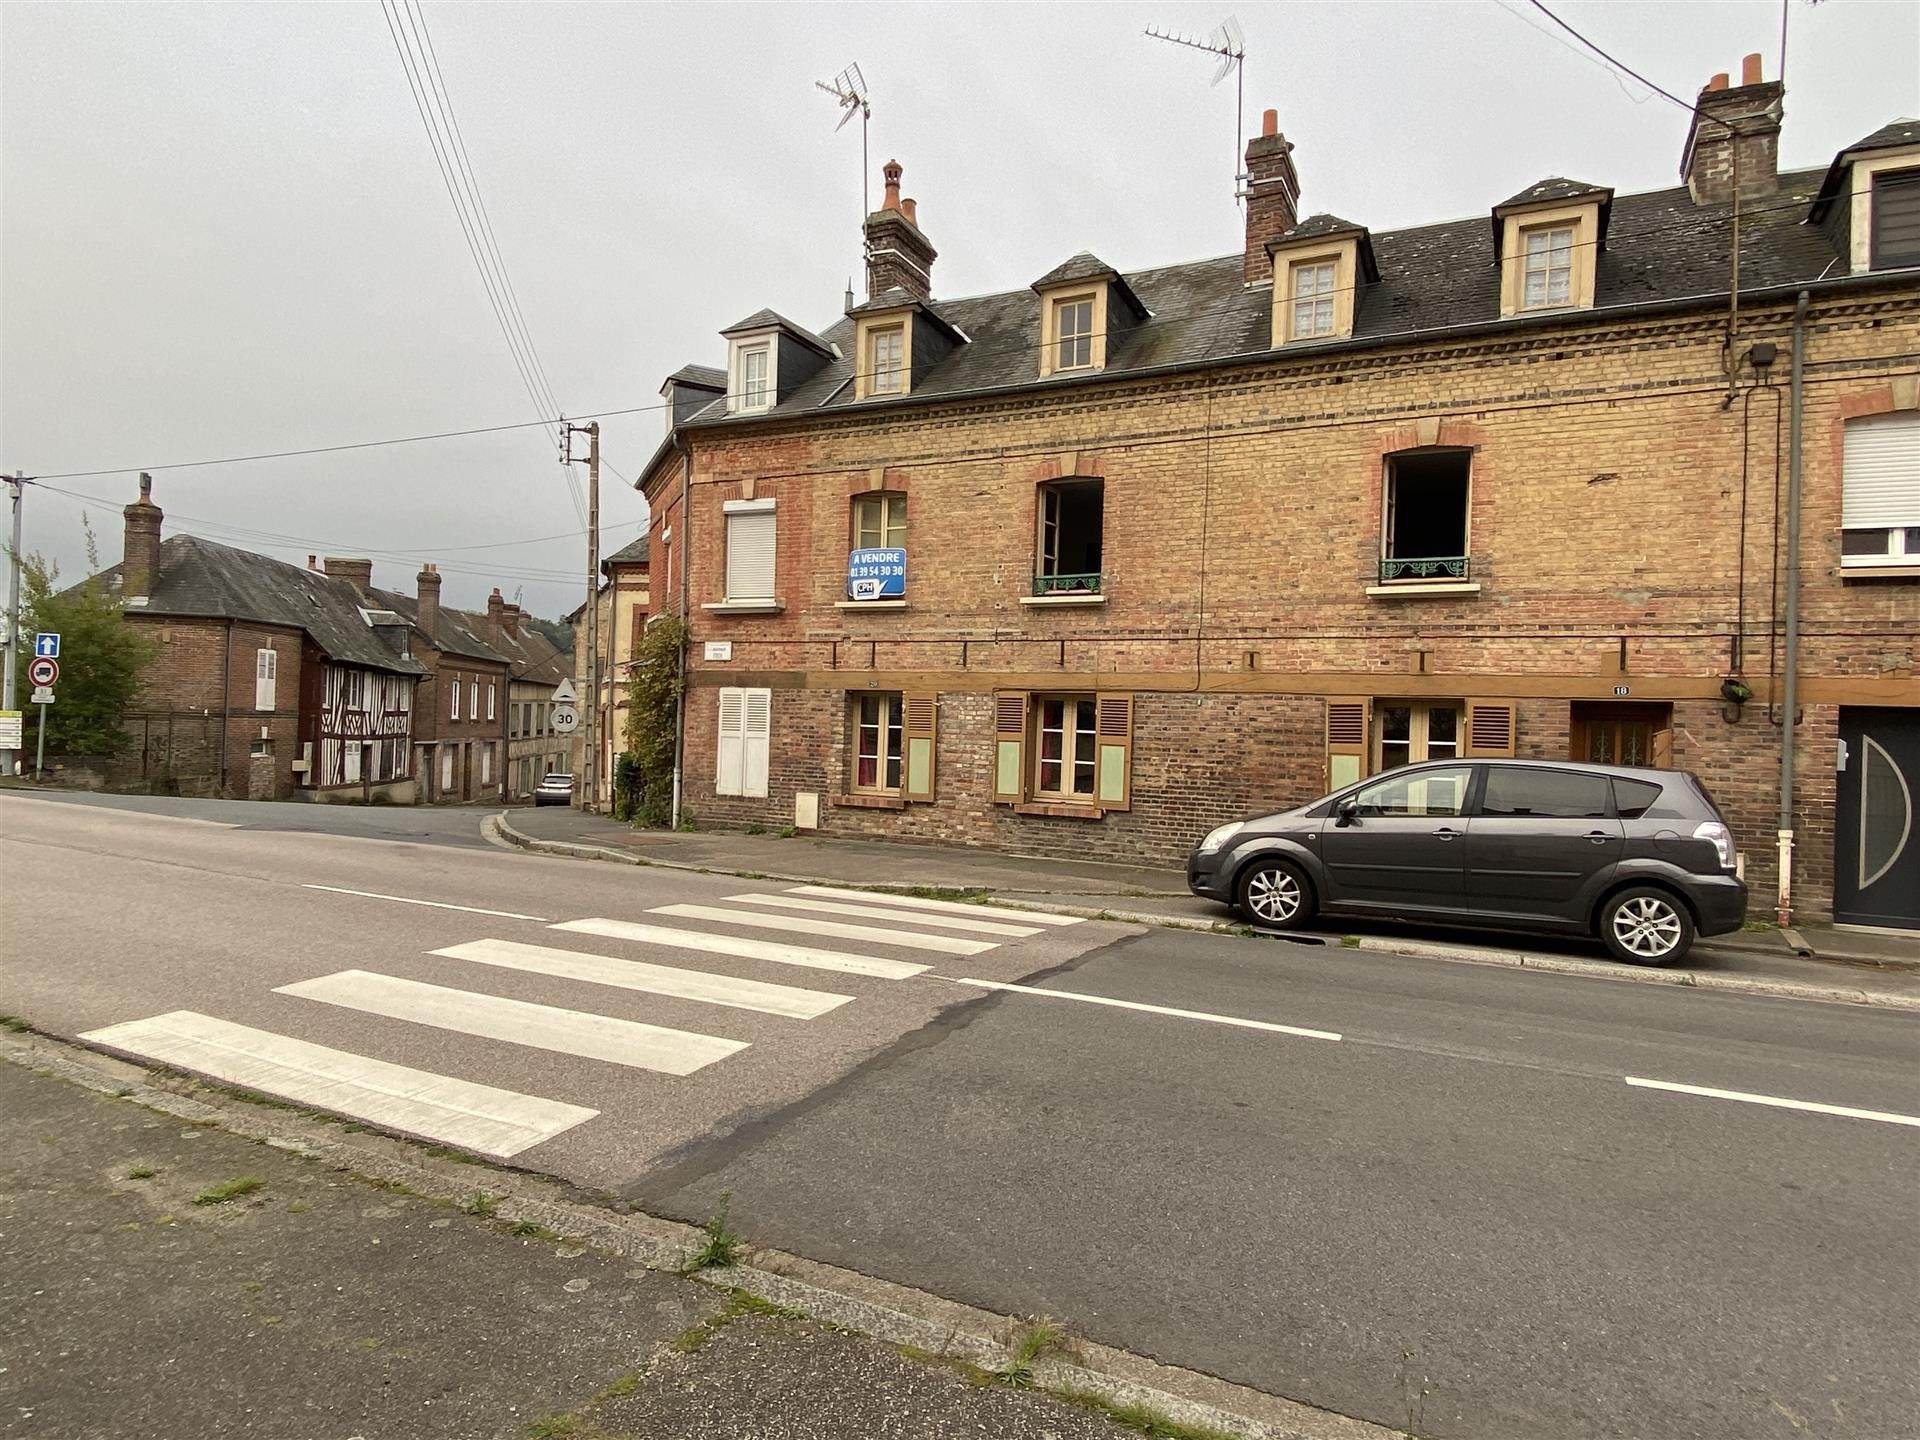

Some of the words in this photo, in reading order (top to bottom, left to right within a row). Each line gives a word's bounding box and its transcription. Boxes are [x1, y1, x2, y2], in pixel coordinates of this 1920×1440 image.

[854, 554, 860, 564] A
[861, 552, 900, 563] VENDRE
[850, 567, 858, 577] 01
[859, 566, 868, 576] 39
[869, 566, 878, 576] 54
[880, 565, 891, 576] 30
[892, 565, 903, 576] 30
[857, 582, 873, 592] CPH
[1616, 687, 1627, 695] 18
[558, 714, 572, 724] 30
